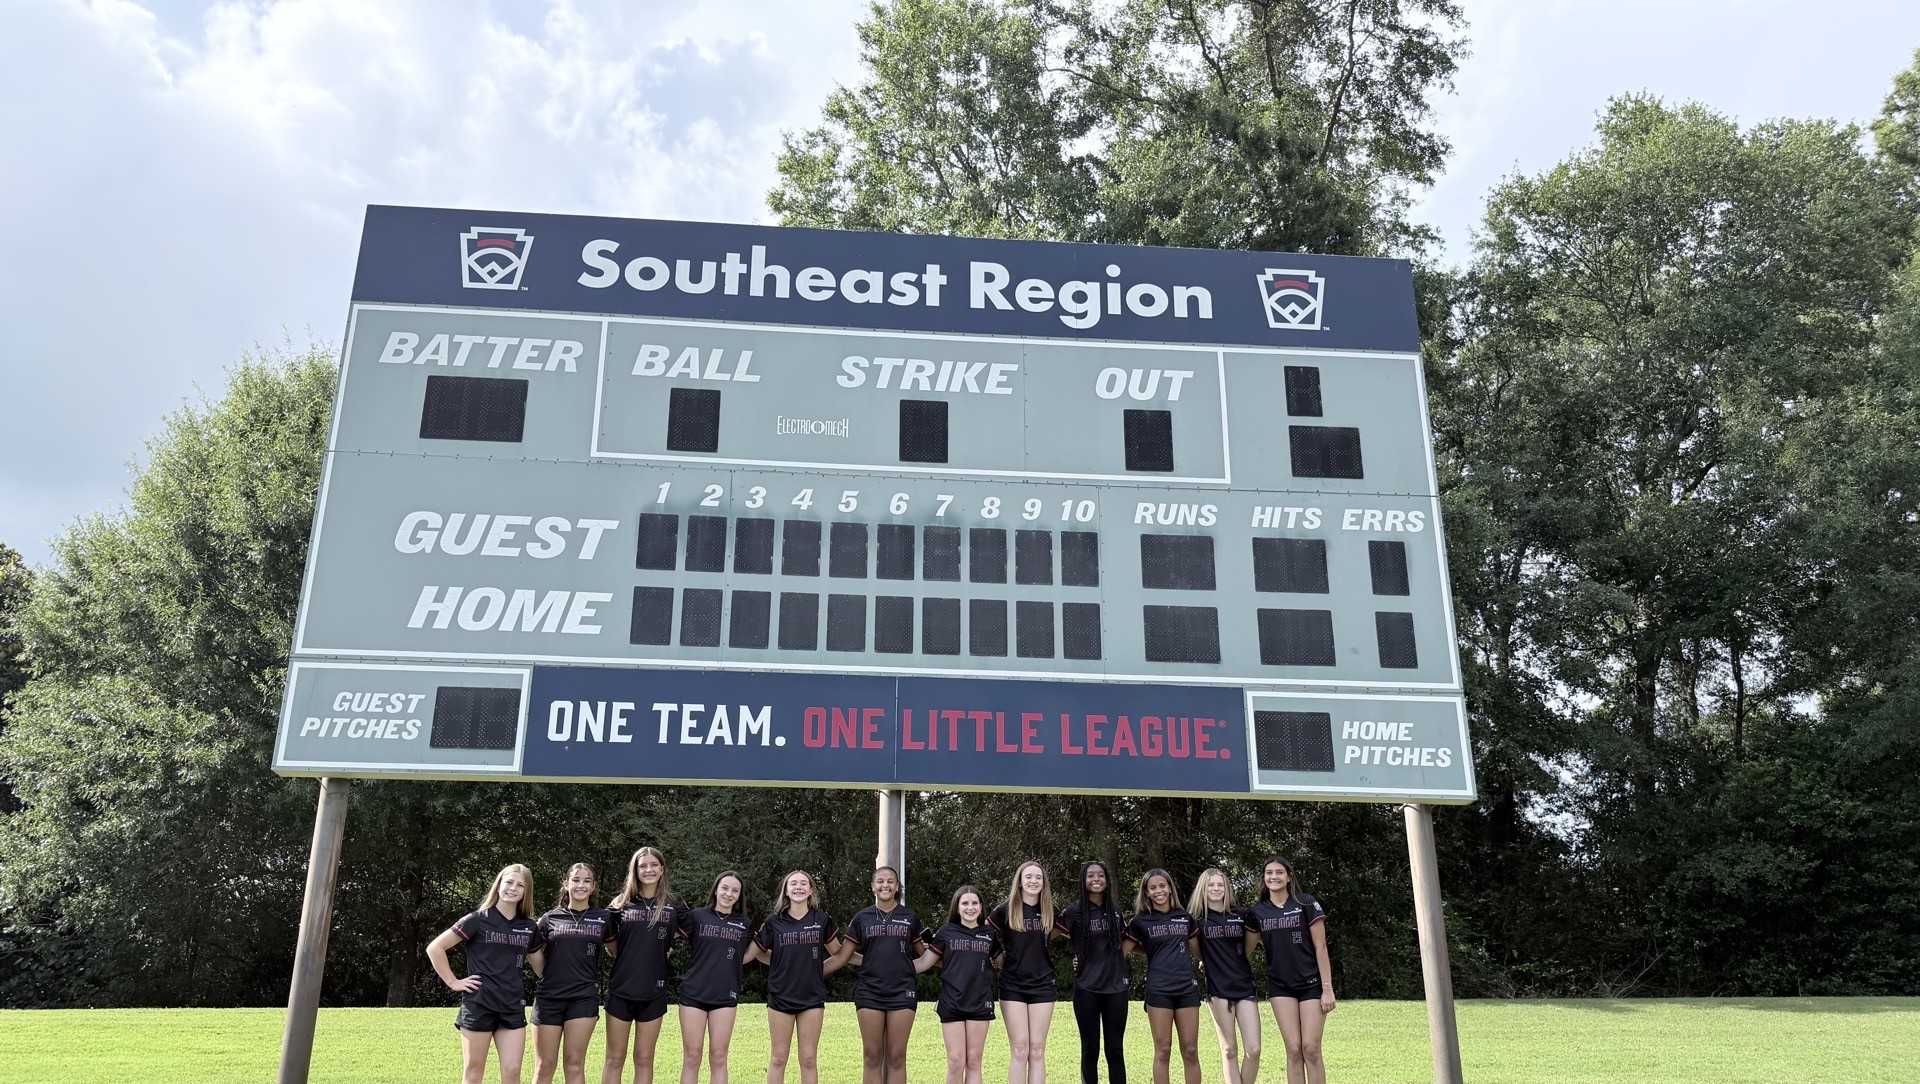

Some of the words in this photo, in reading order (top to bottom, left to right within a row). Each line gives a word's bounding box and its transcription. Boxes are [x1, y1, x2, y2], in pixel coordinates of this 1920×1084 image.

[576, 238, 948, 308] Southeast
[969, 261, 1213, 330] Region
[378, 331, 584, 373] BATTER
[631, 343, 761, 383] BALL
[836, 355, 1019, 395] STRIKE
[1095, 367, 1195, 401] OUT
[656, 481, 672, 504] 1
[699, 484, 724, 507] 2
[744, 485, 767, 509] 3
[791, 488, 814, 511] 4
[837, 490, 860, 513] 5
[889, 492, 910, 515] 6
[935, 494, 955, 517] 7
[980, 496, 1001, 519] 8
[1021, 498, 1042, 521] 9
[1061, 499, 1096, 522] 10
[1133, 502, 1218, 527] RUNS
[1251, 505, 1323, 530] HITS
[1341, 508, 1425, 533] ERRS
[394, 510, 621, 560] GUEST
[407, 585, 614, 635] HOME
[332, 691, 427, 714] GUEST
[299, 717, 422, 741] PITCHES
[547, 700, 636, 743] ONE
[651, 702, 786, 747] TEAM.
[803, 707, 884, 750] ONE
[902, 708, 1044, 753] LITTLE
[1341, 720, 1414, 741] HOME
[1344, 745, 1452, 768] PITCHES
